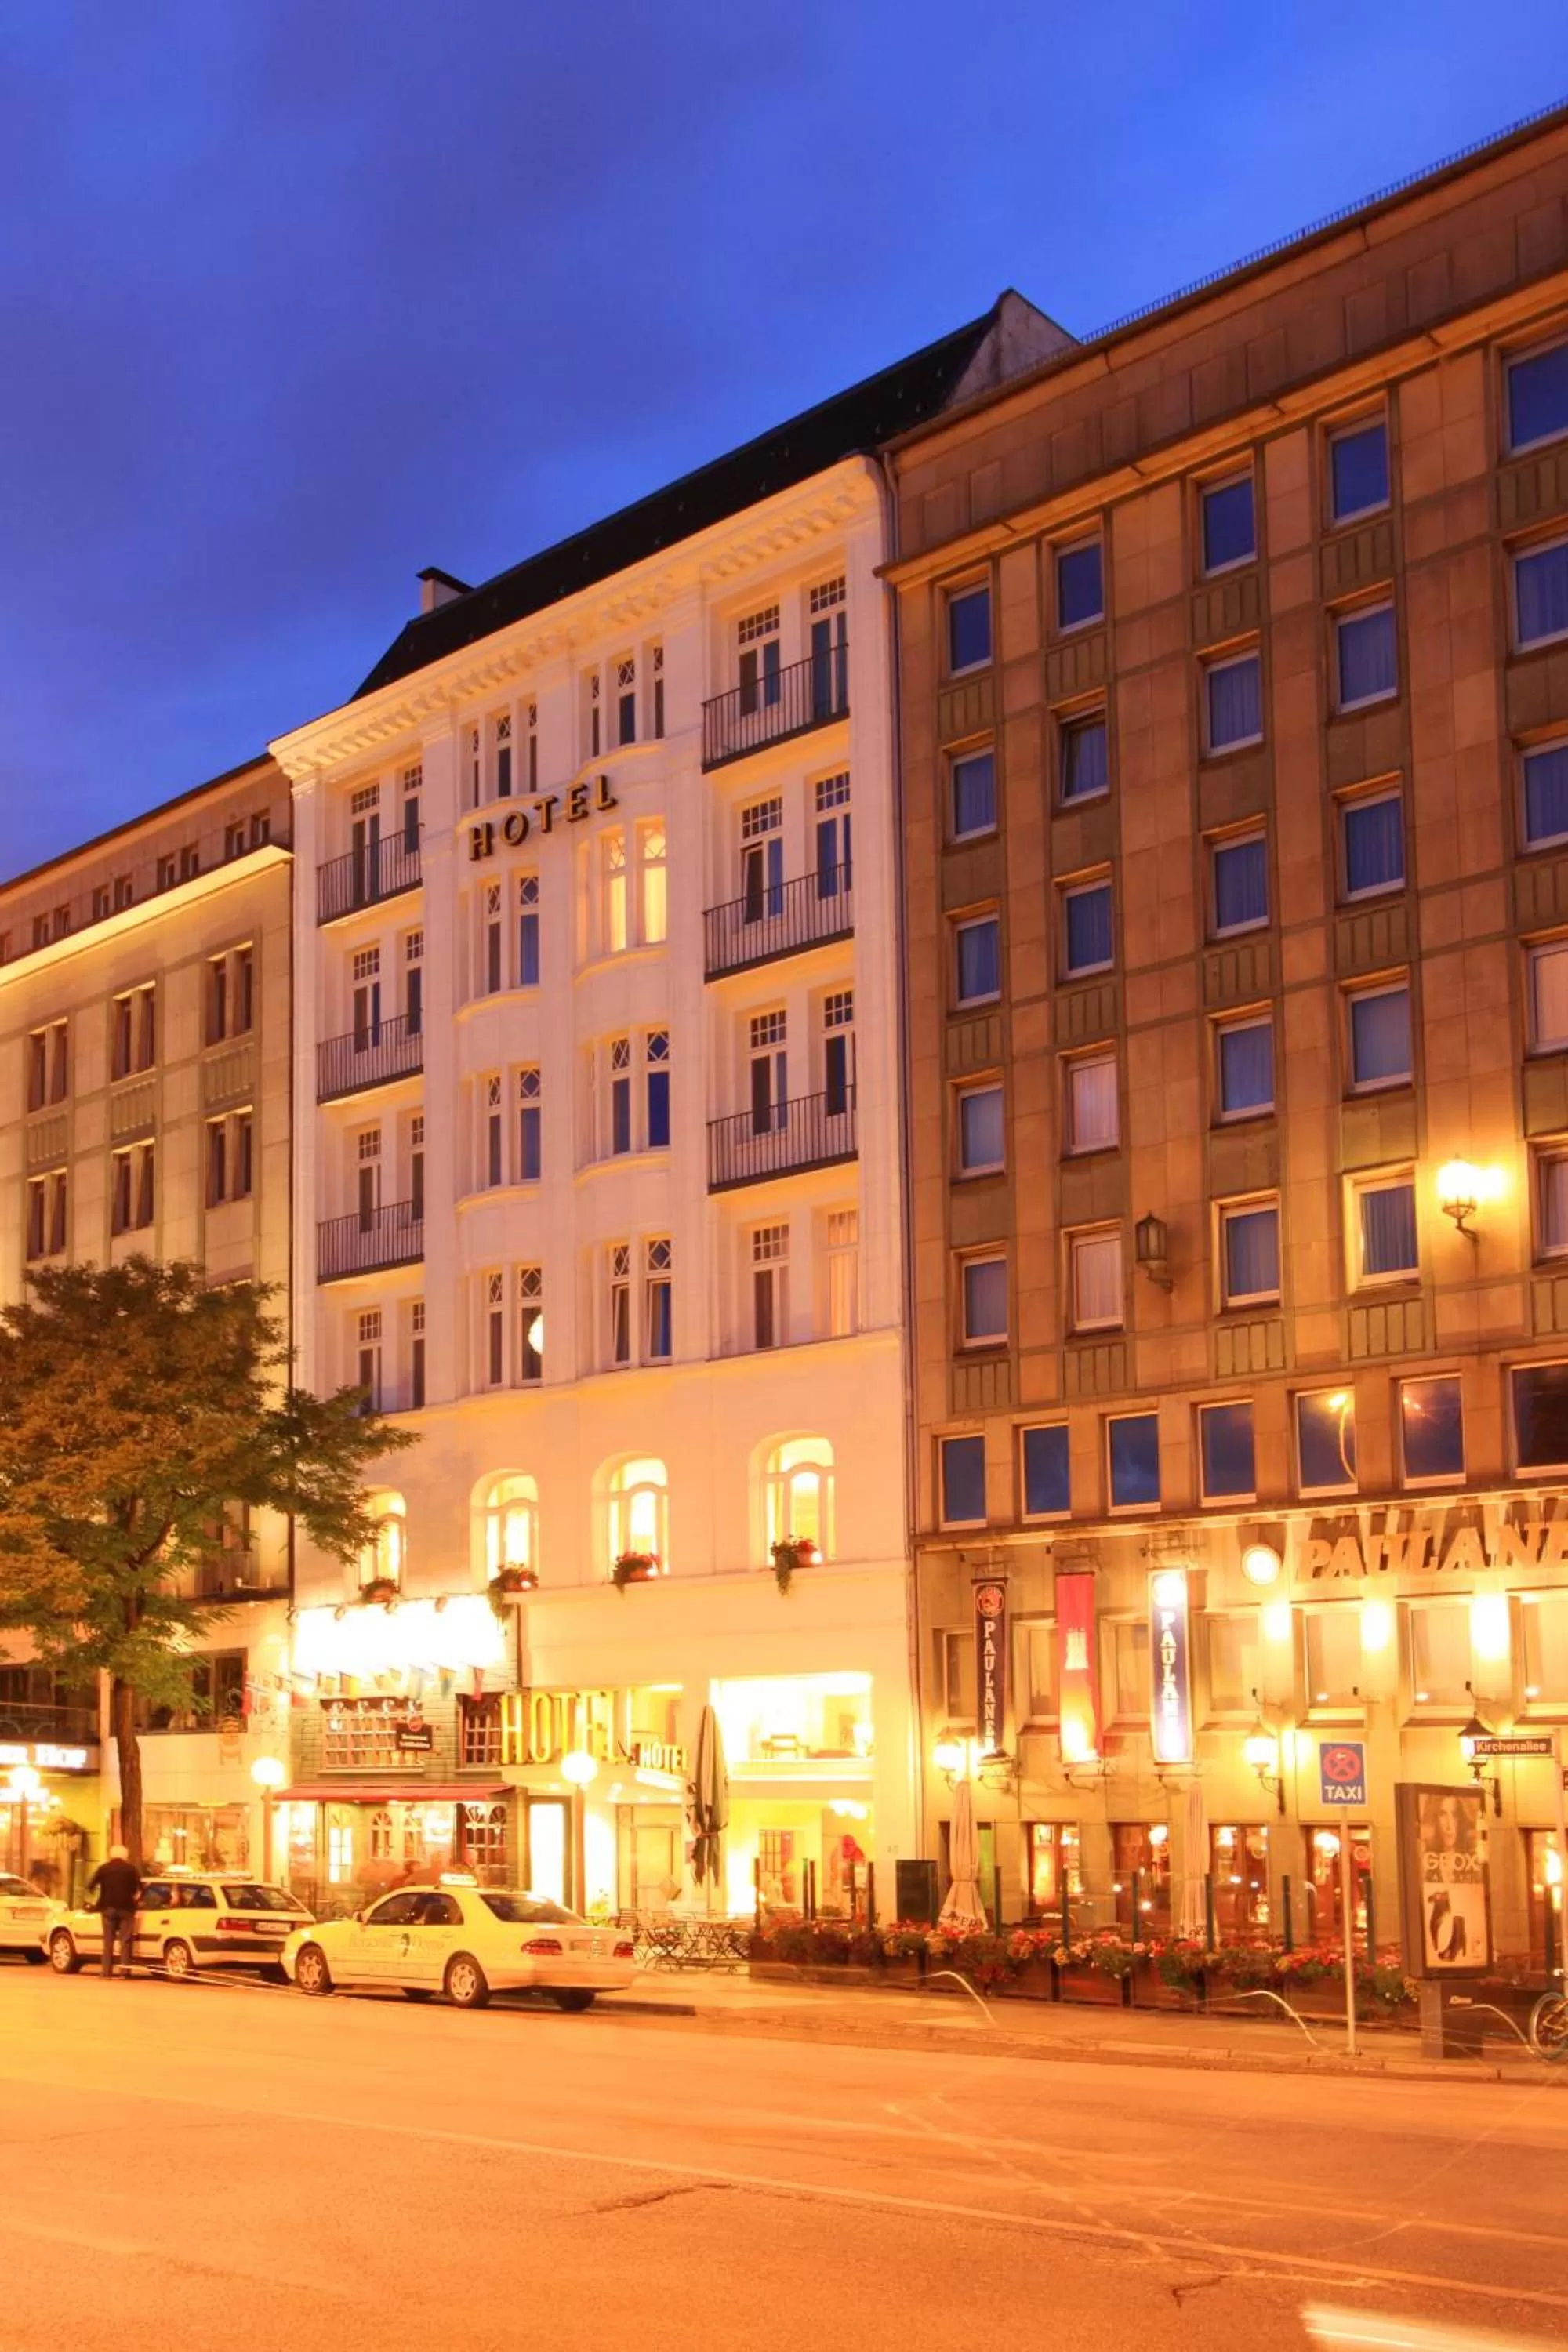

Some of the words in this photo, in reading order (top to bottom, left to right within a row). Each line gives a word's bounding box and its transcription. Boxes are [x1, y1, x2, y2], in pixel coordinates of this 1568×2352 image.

[469, 774, 618, 861] HOTEL
[640, 1741, 688, 1770] HOTEL
[1476, 1740, 1547, 1753] Kirchenallee
[1323, 1785, 1362, 1801] TAXI
[1424, 1852, 1481, 1871] GEOX
